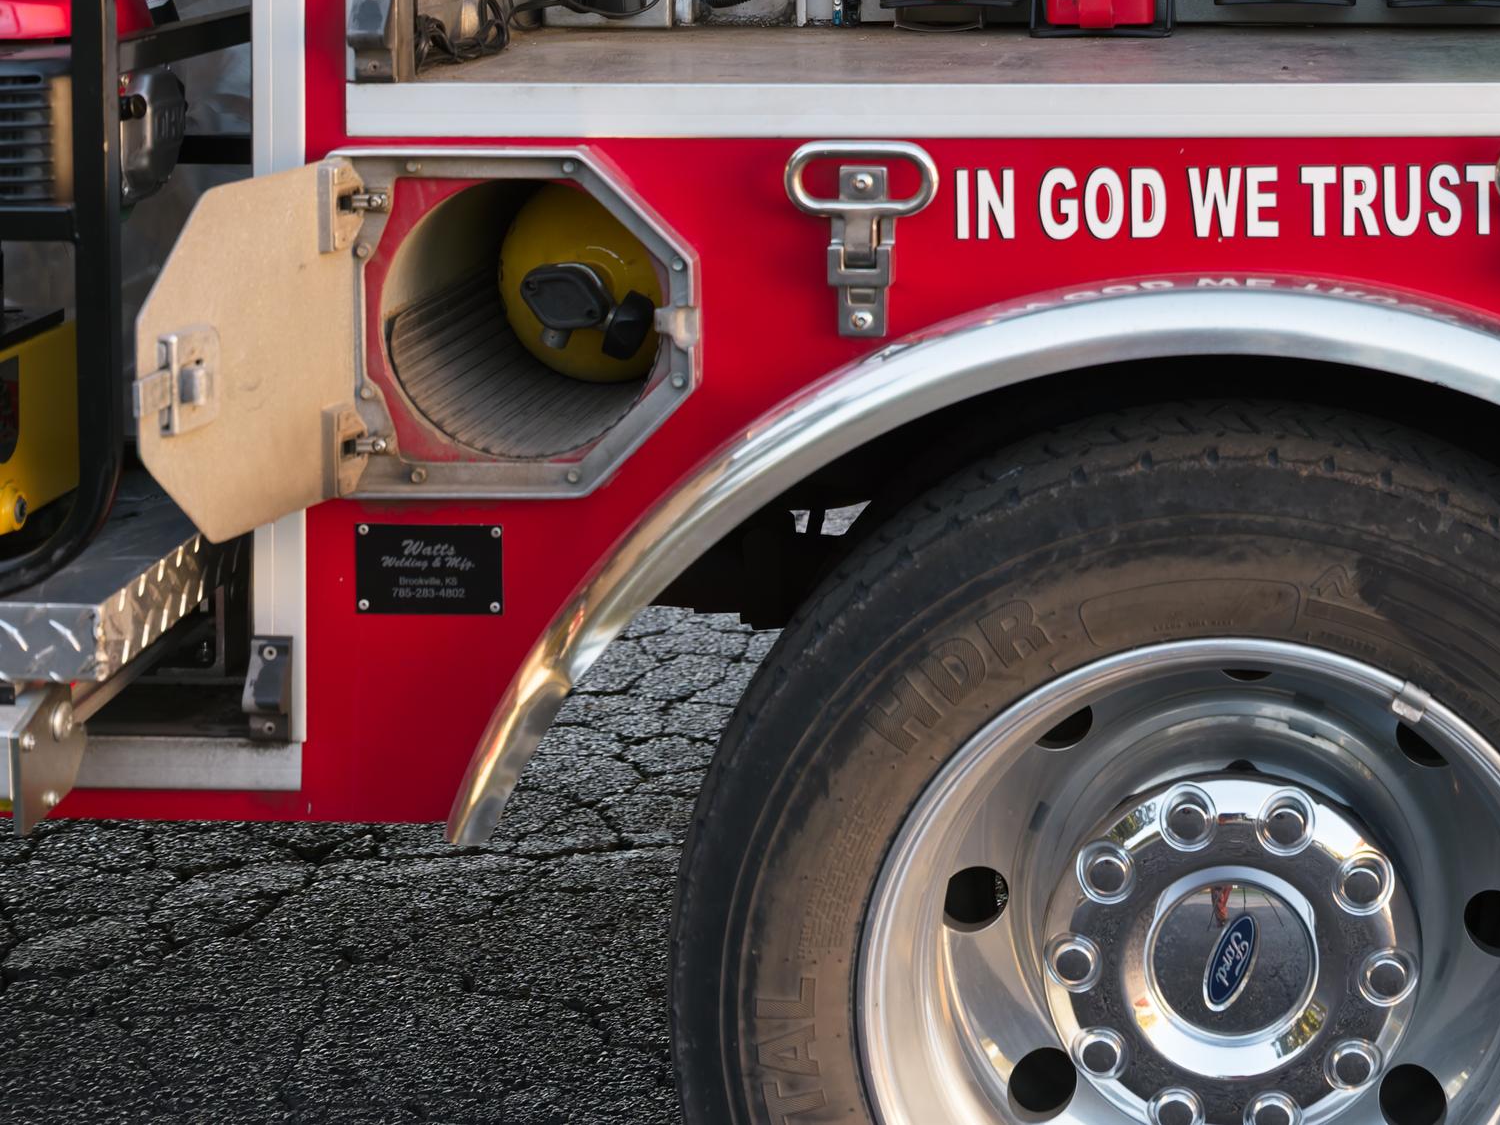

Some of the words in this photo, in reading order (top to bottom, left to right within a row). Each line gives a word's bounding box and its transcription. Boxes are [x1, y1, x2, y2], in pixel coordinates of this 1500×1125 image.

[955, 167, 1016, 240] IN
[1038, 166, 1167, 240] GOD
[1188, 166, 1279, 239] WE
[1300, 164, 1496, 237] TRUST
[381, 556, 428, 570] Welding
[432, 557, 441, 567] &
[402, 539, 456, 555] Watts
[1216, 931, 1249, 987] Ford
